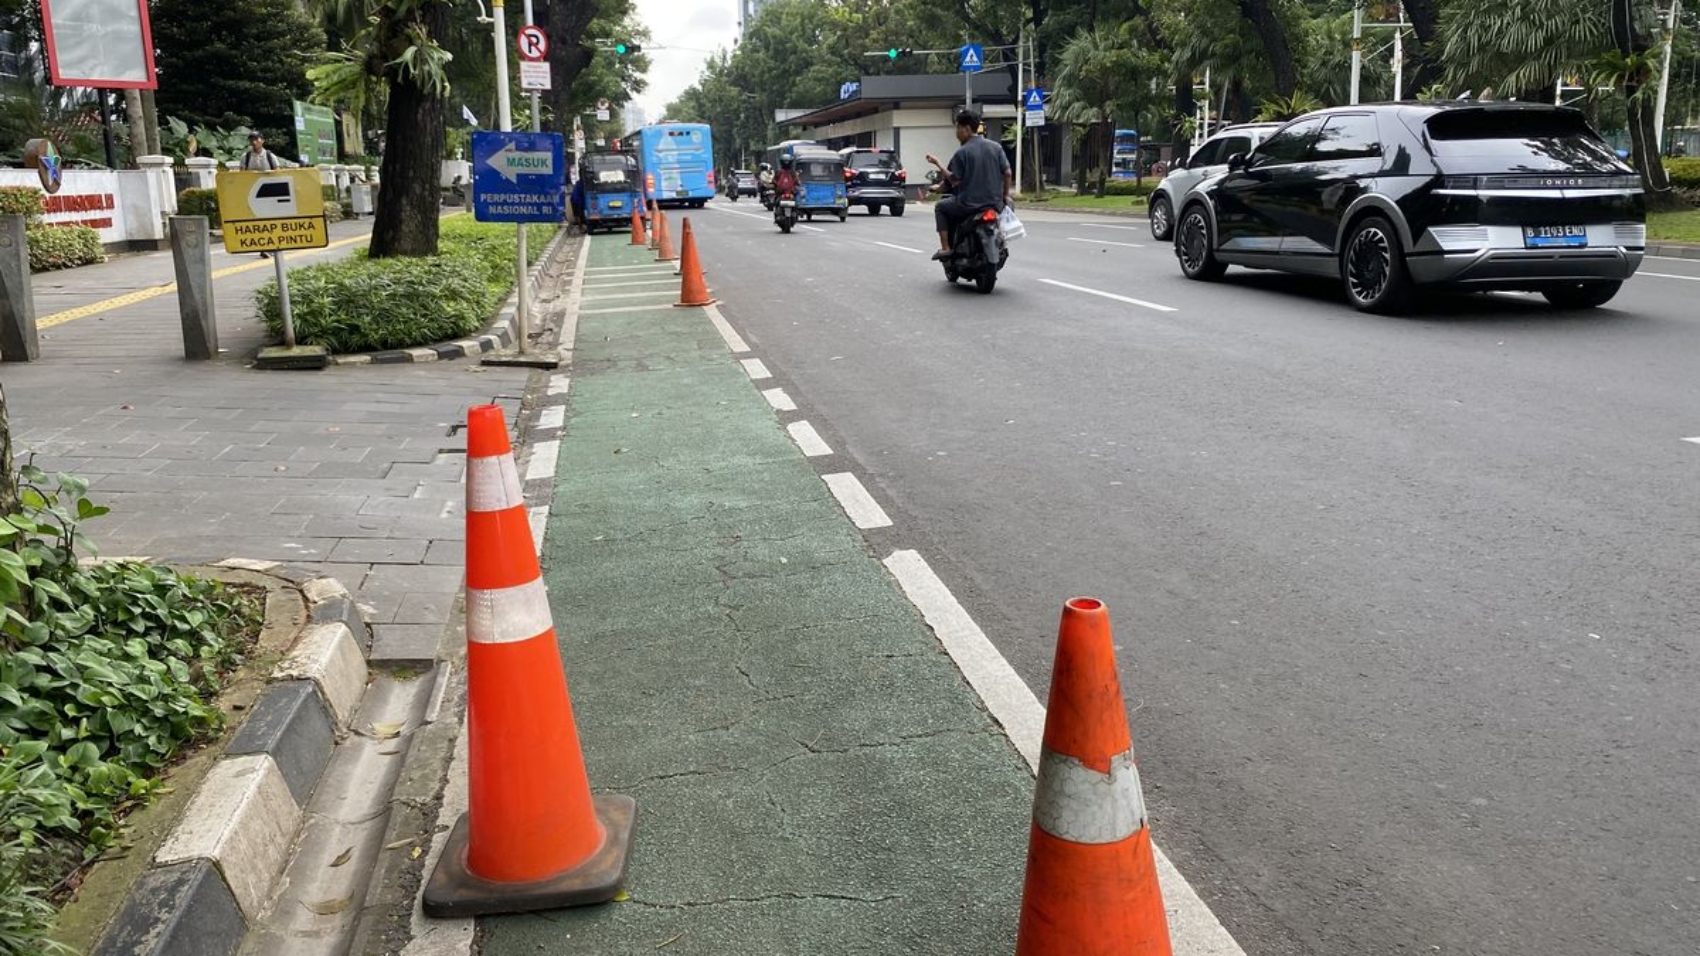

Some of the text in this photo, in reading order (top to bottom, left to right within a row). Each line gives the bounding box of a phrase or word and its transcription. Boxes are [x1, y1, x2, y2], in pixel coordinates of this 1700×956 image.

[506, 158, 549, 169] MASUK
[480, 193, 560, 204] PERPUSTAKAAN
[489, 205, 553, 216] NASIONAL RI
[235, 221, 316, 236] HARAP BUKA
[1527, 227, 1534, 238] B
[1539, 226, 1563, 238] 1193
[240, 234, 314, 248] KACA PINTU
